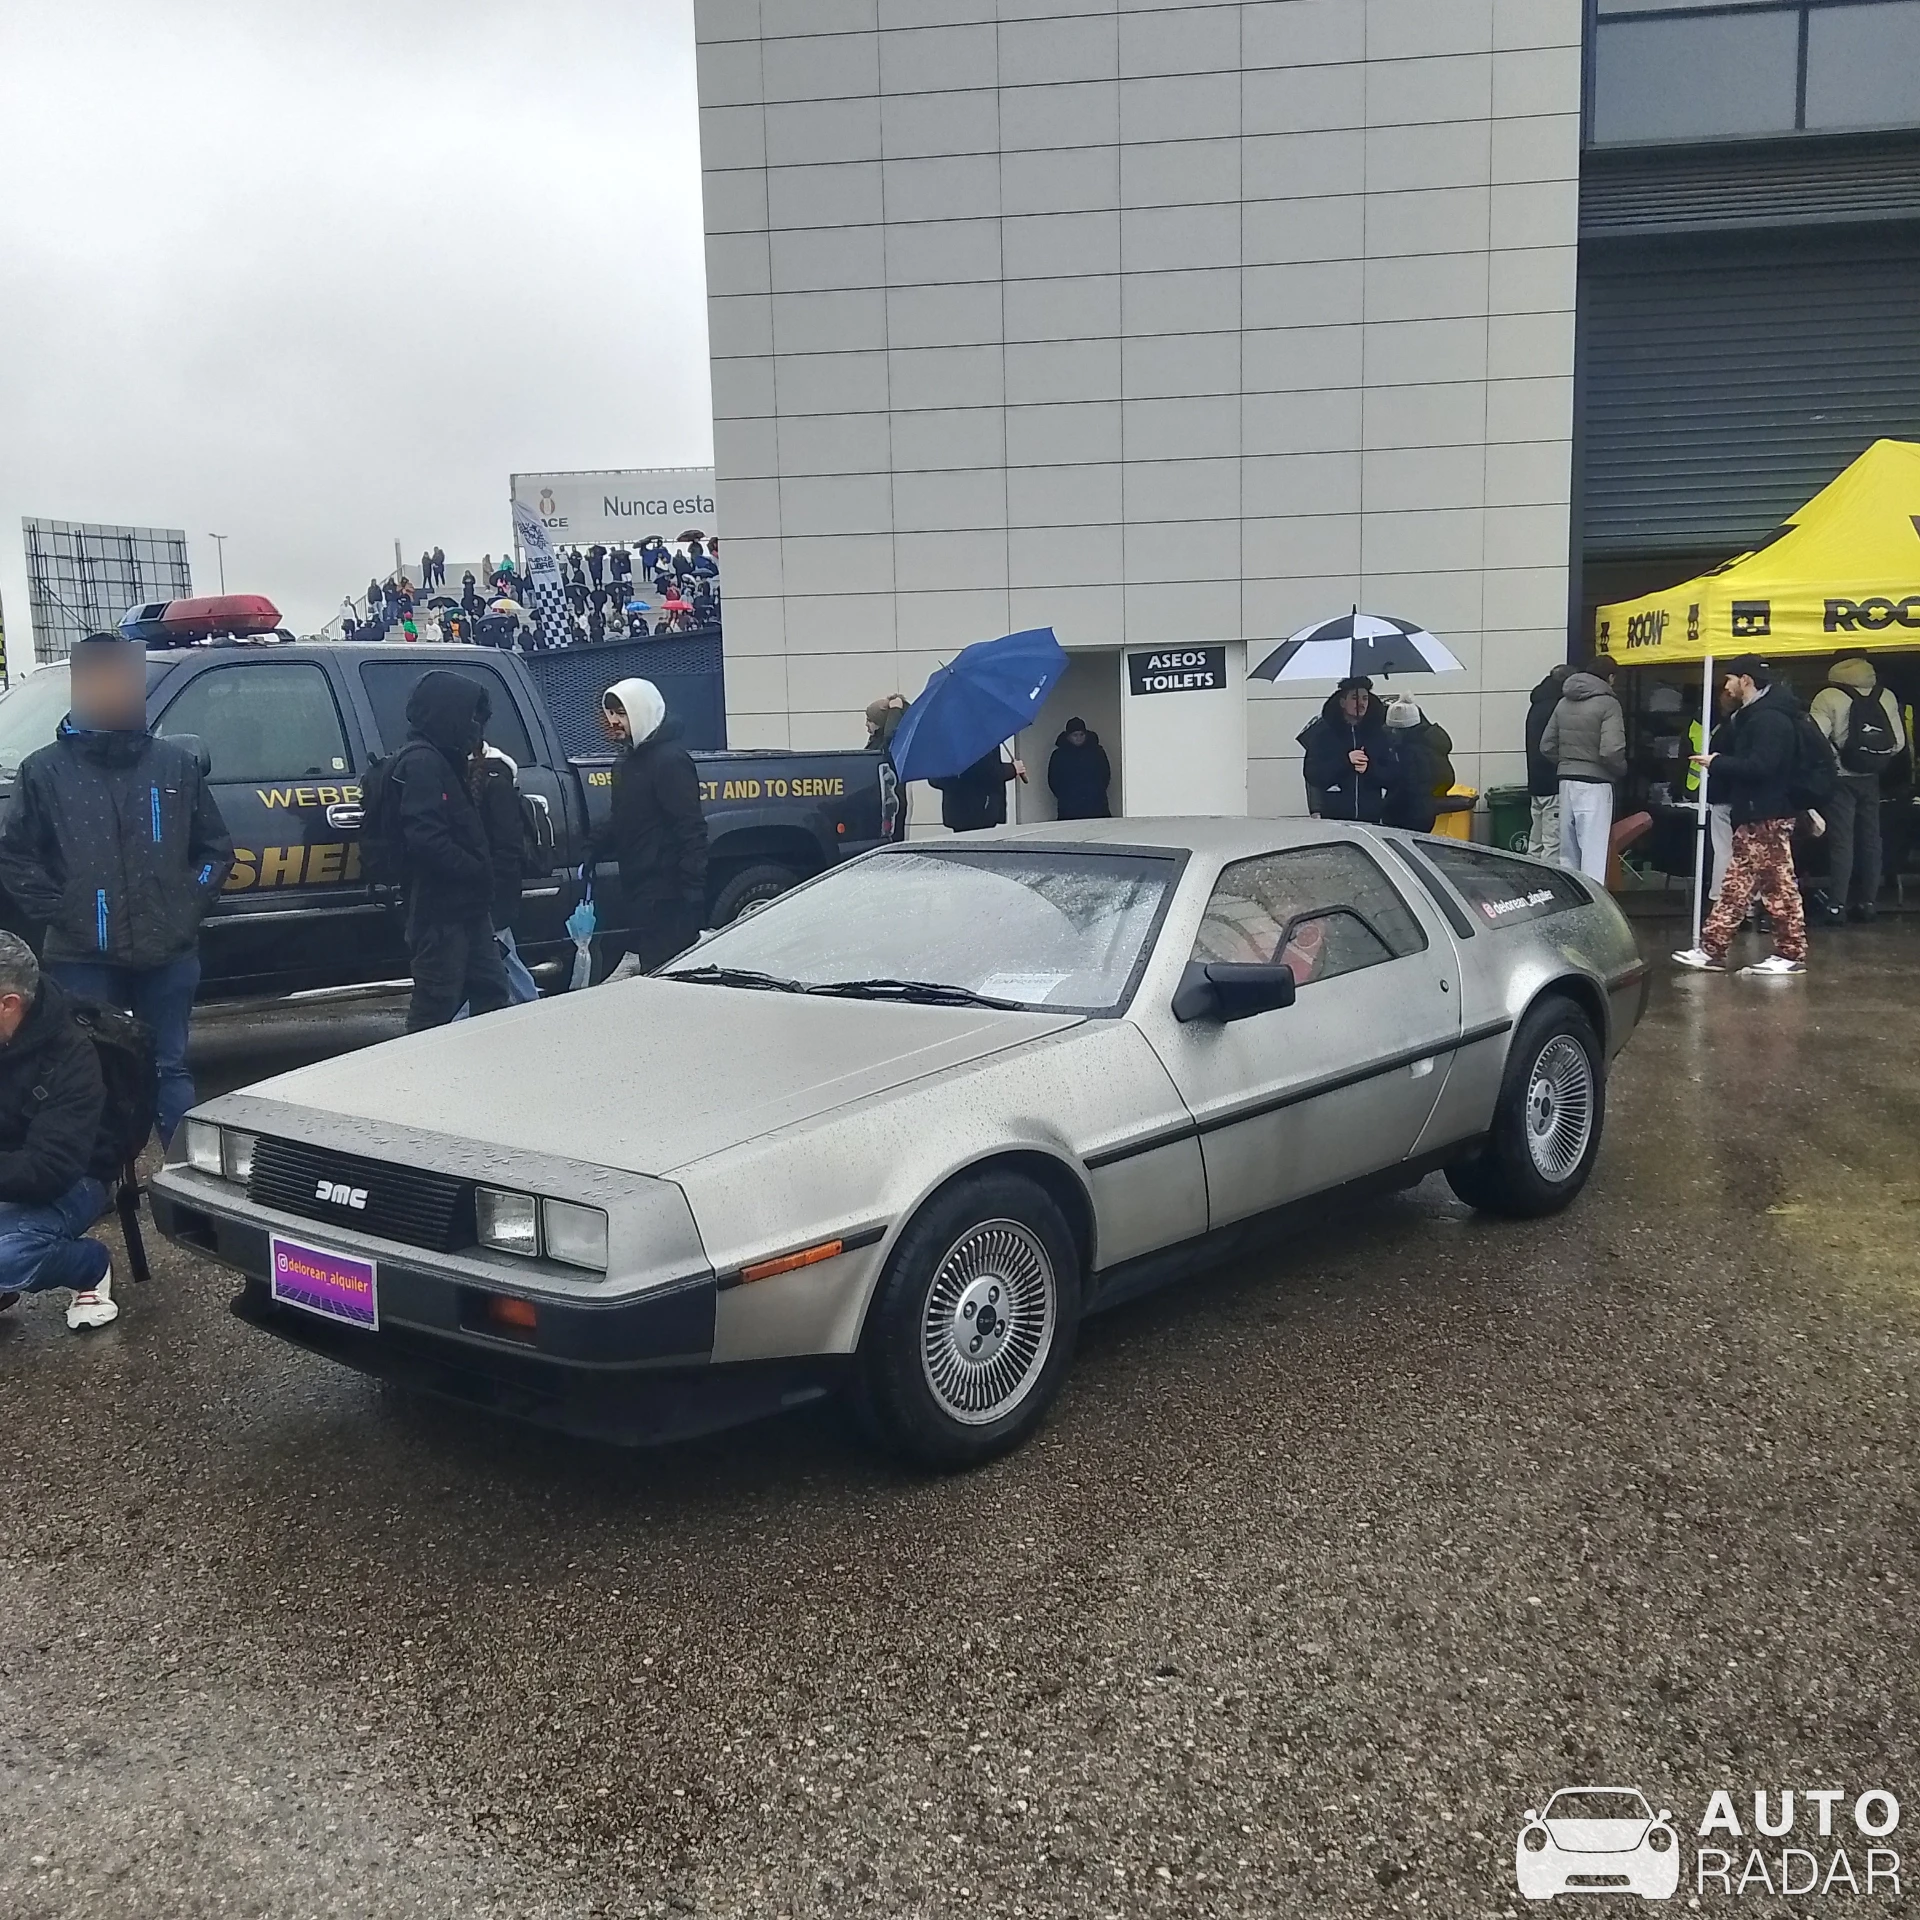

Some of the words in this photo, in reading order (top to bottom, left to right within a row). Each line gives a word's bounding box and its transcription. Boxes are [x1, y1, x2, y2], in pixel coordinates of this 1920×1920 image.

[604, 496, 668, 517] Nunca
[673, 495, 715, 514] esta
[541, 517, 569, 528] ACE
[1147, 651, 1206, 669] ASEOS
[1142, 672, 1214, 691] TOILETS
[256, 785, 364, 809] WEBB
[722, 780, 760, 799] AND
[764, 779, 788, 798] TO
[791, 778, 844, 797] SERVE
[288, 1257, 369, 1293] delorean_alquiler
